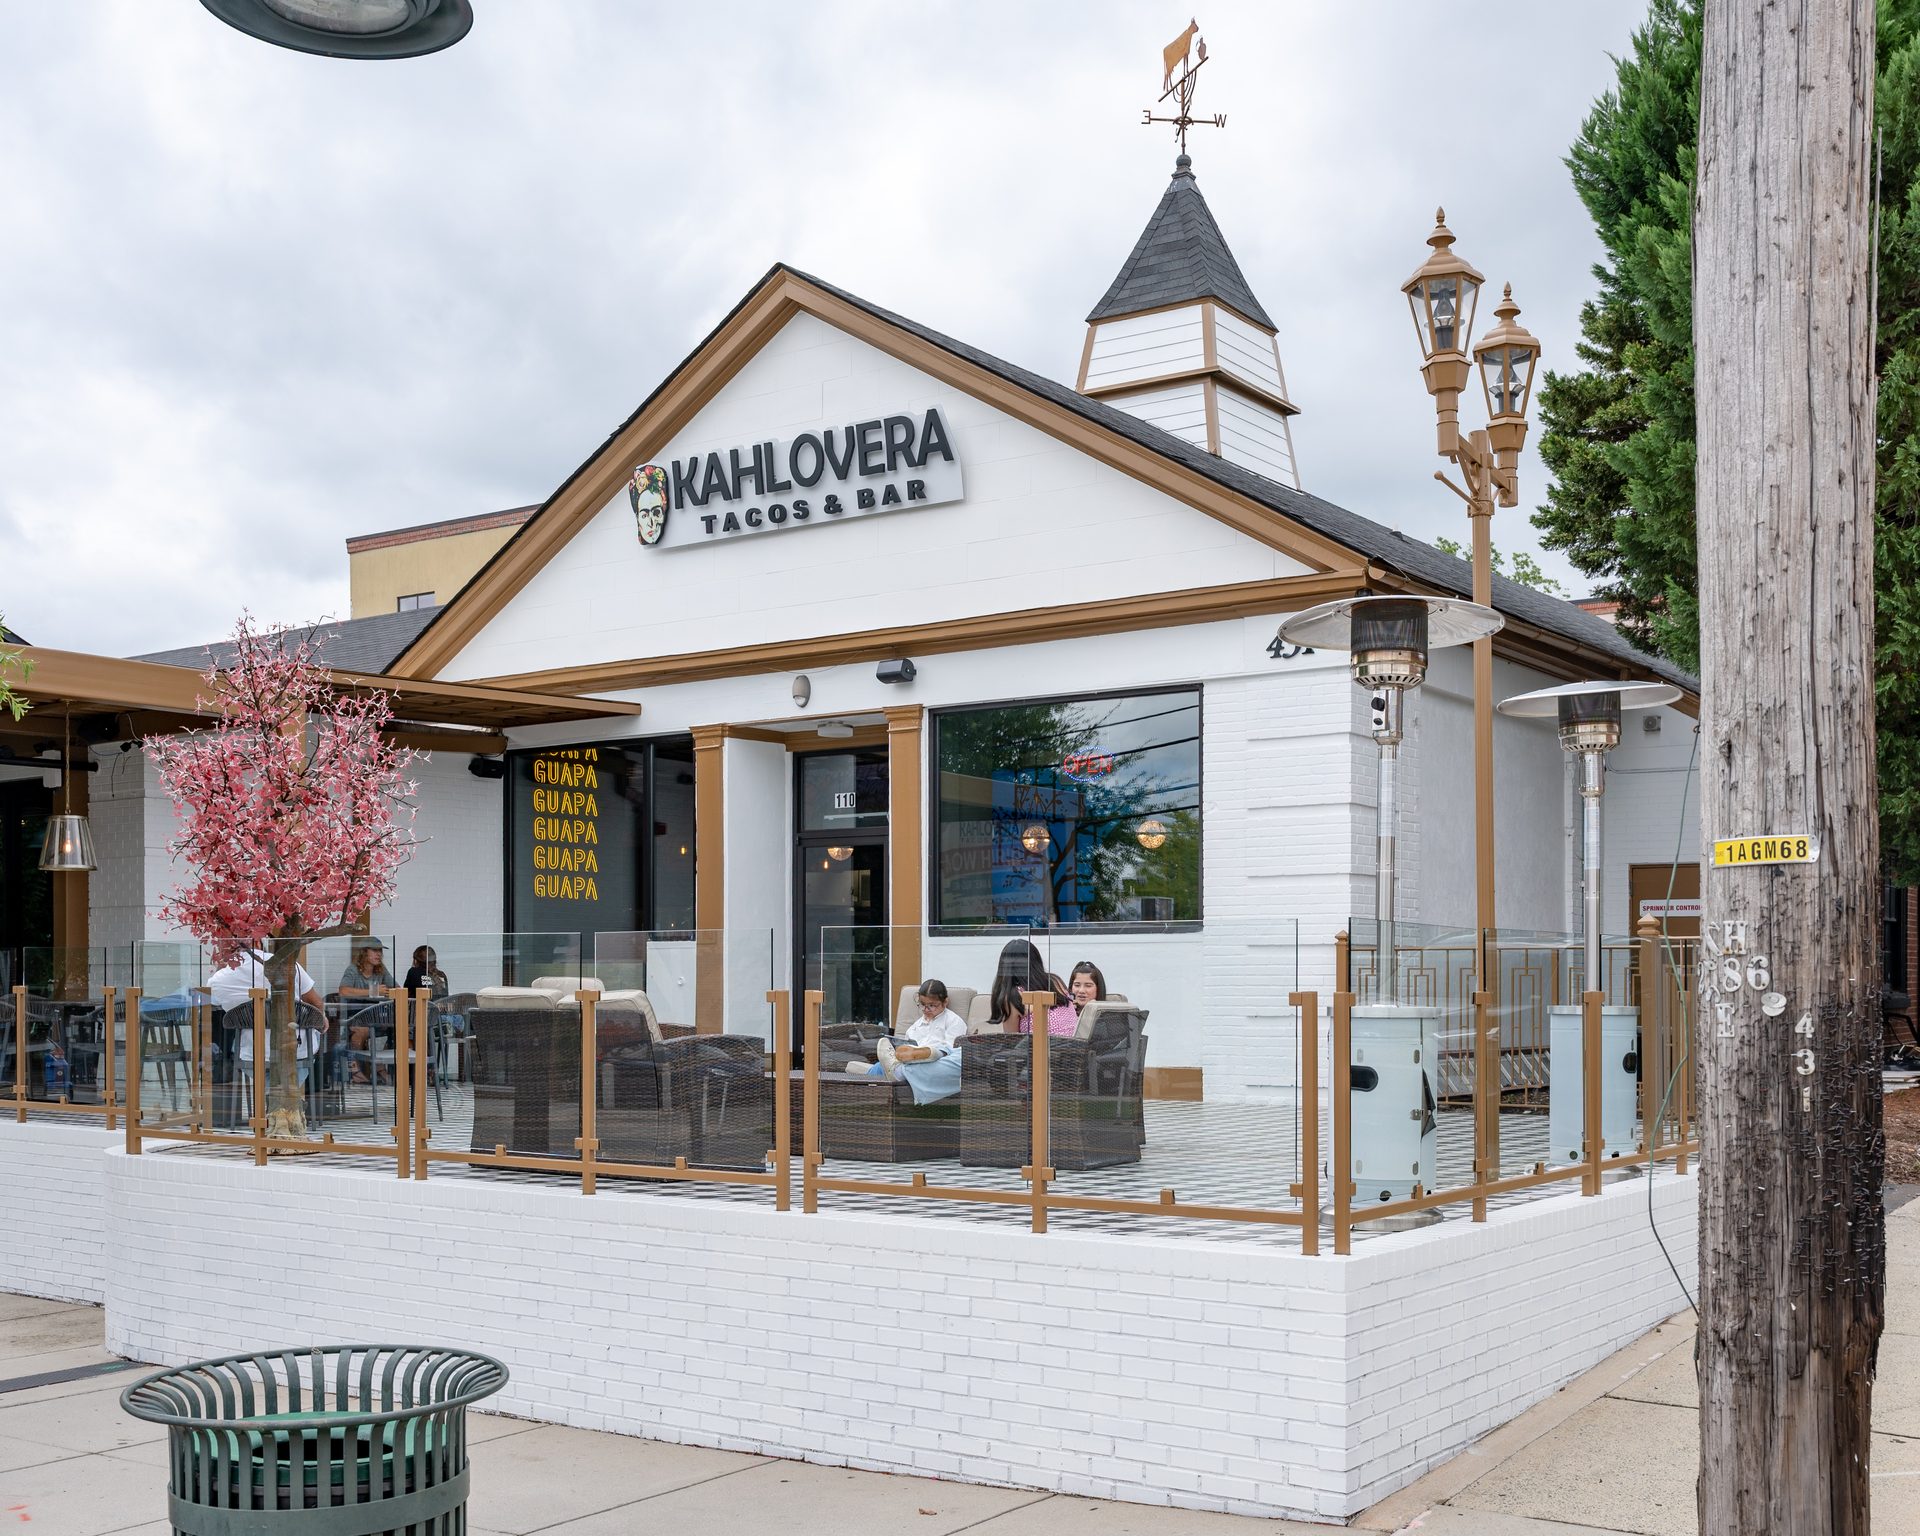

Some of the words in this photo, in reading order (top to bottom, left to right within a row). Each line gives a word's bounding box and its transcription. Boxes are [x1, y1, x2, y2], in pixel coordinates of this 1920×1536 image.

[671, 408, 954, 510] KAHLOVERA
[700, 499, 810, 535] TACOS
[823, 494, 843, 515] &
[856, 479, 927, 510] BAR
[534, 759, 598, 788] GUAPA
[1063, 754, 1113, 774] OPEN
[534, 788, 598, 817] GUAPA
[836, 793, 855, 808] 110
[534, 816, 598, 845] GUAPA
[534, 845, 598, 873] GUAPA
[1726, 840, 1807, 863] 1AGM68
[534, 874, 598, 901] GUAPA
